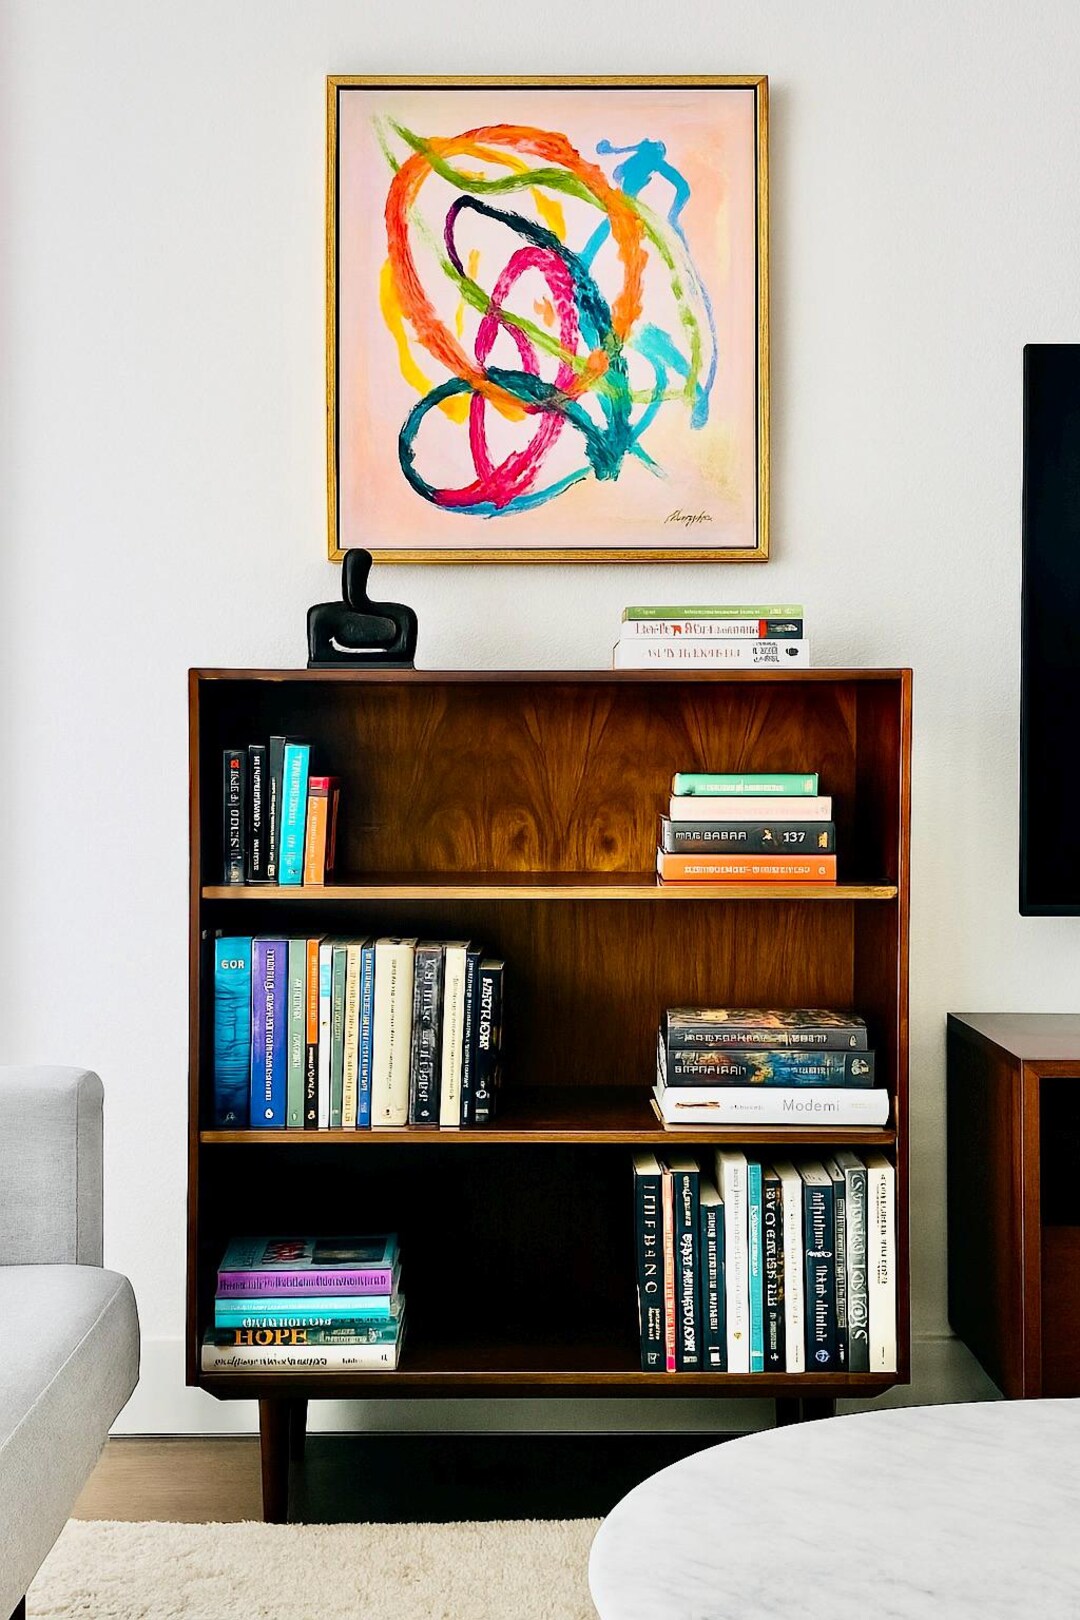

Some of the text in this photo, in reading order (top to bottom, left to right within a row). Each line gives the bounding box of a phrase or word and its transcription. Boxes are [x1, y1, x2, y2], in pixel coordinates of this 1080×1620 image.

[783, 831, 806, 843] 137
[221, 959, 245, 969] GOR
[234, 1328, 310, 1346] HOPE
